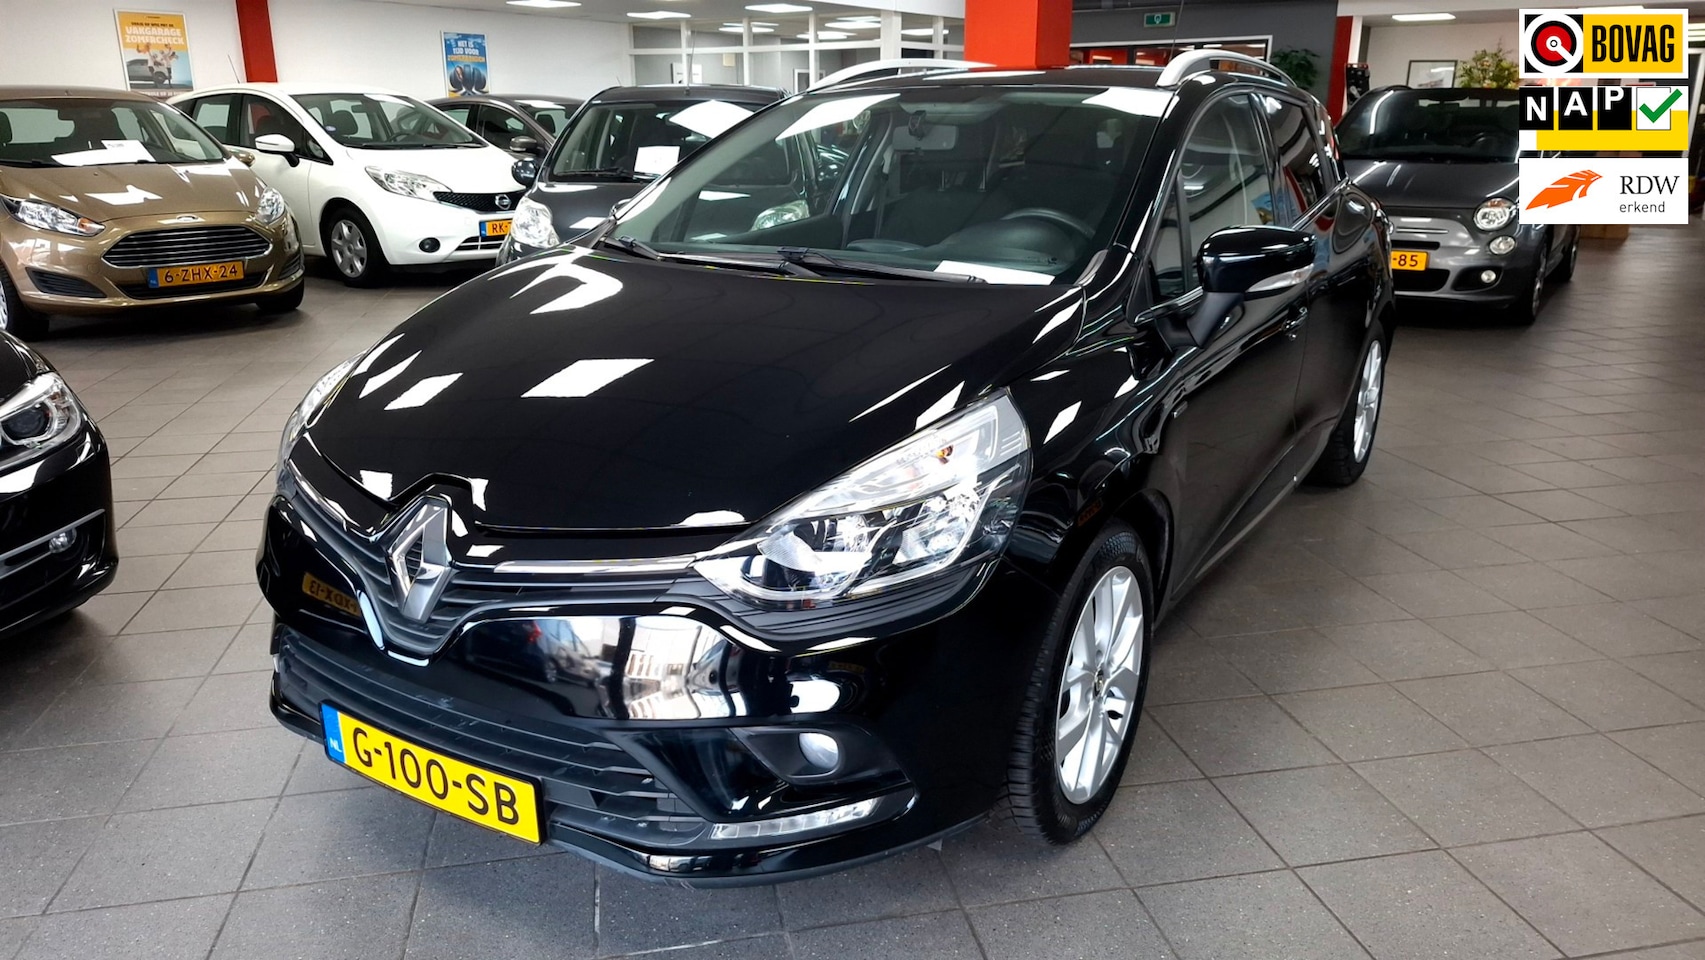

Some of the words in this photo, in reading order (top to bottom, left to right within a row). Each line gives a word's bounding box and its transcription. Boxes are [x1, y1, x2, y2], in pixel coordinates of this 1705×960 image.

[125, 26, 182, 36] VAKGARAGE
[126, 34, 184, 45] ZOMERCHECK
[164, 264, 238, 283] 6-ZHX-24
[330, 736, 342, 752] NL
[352, 727, 520, 826] G-100-SB
